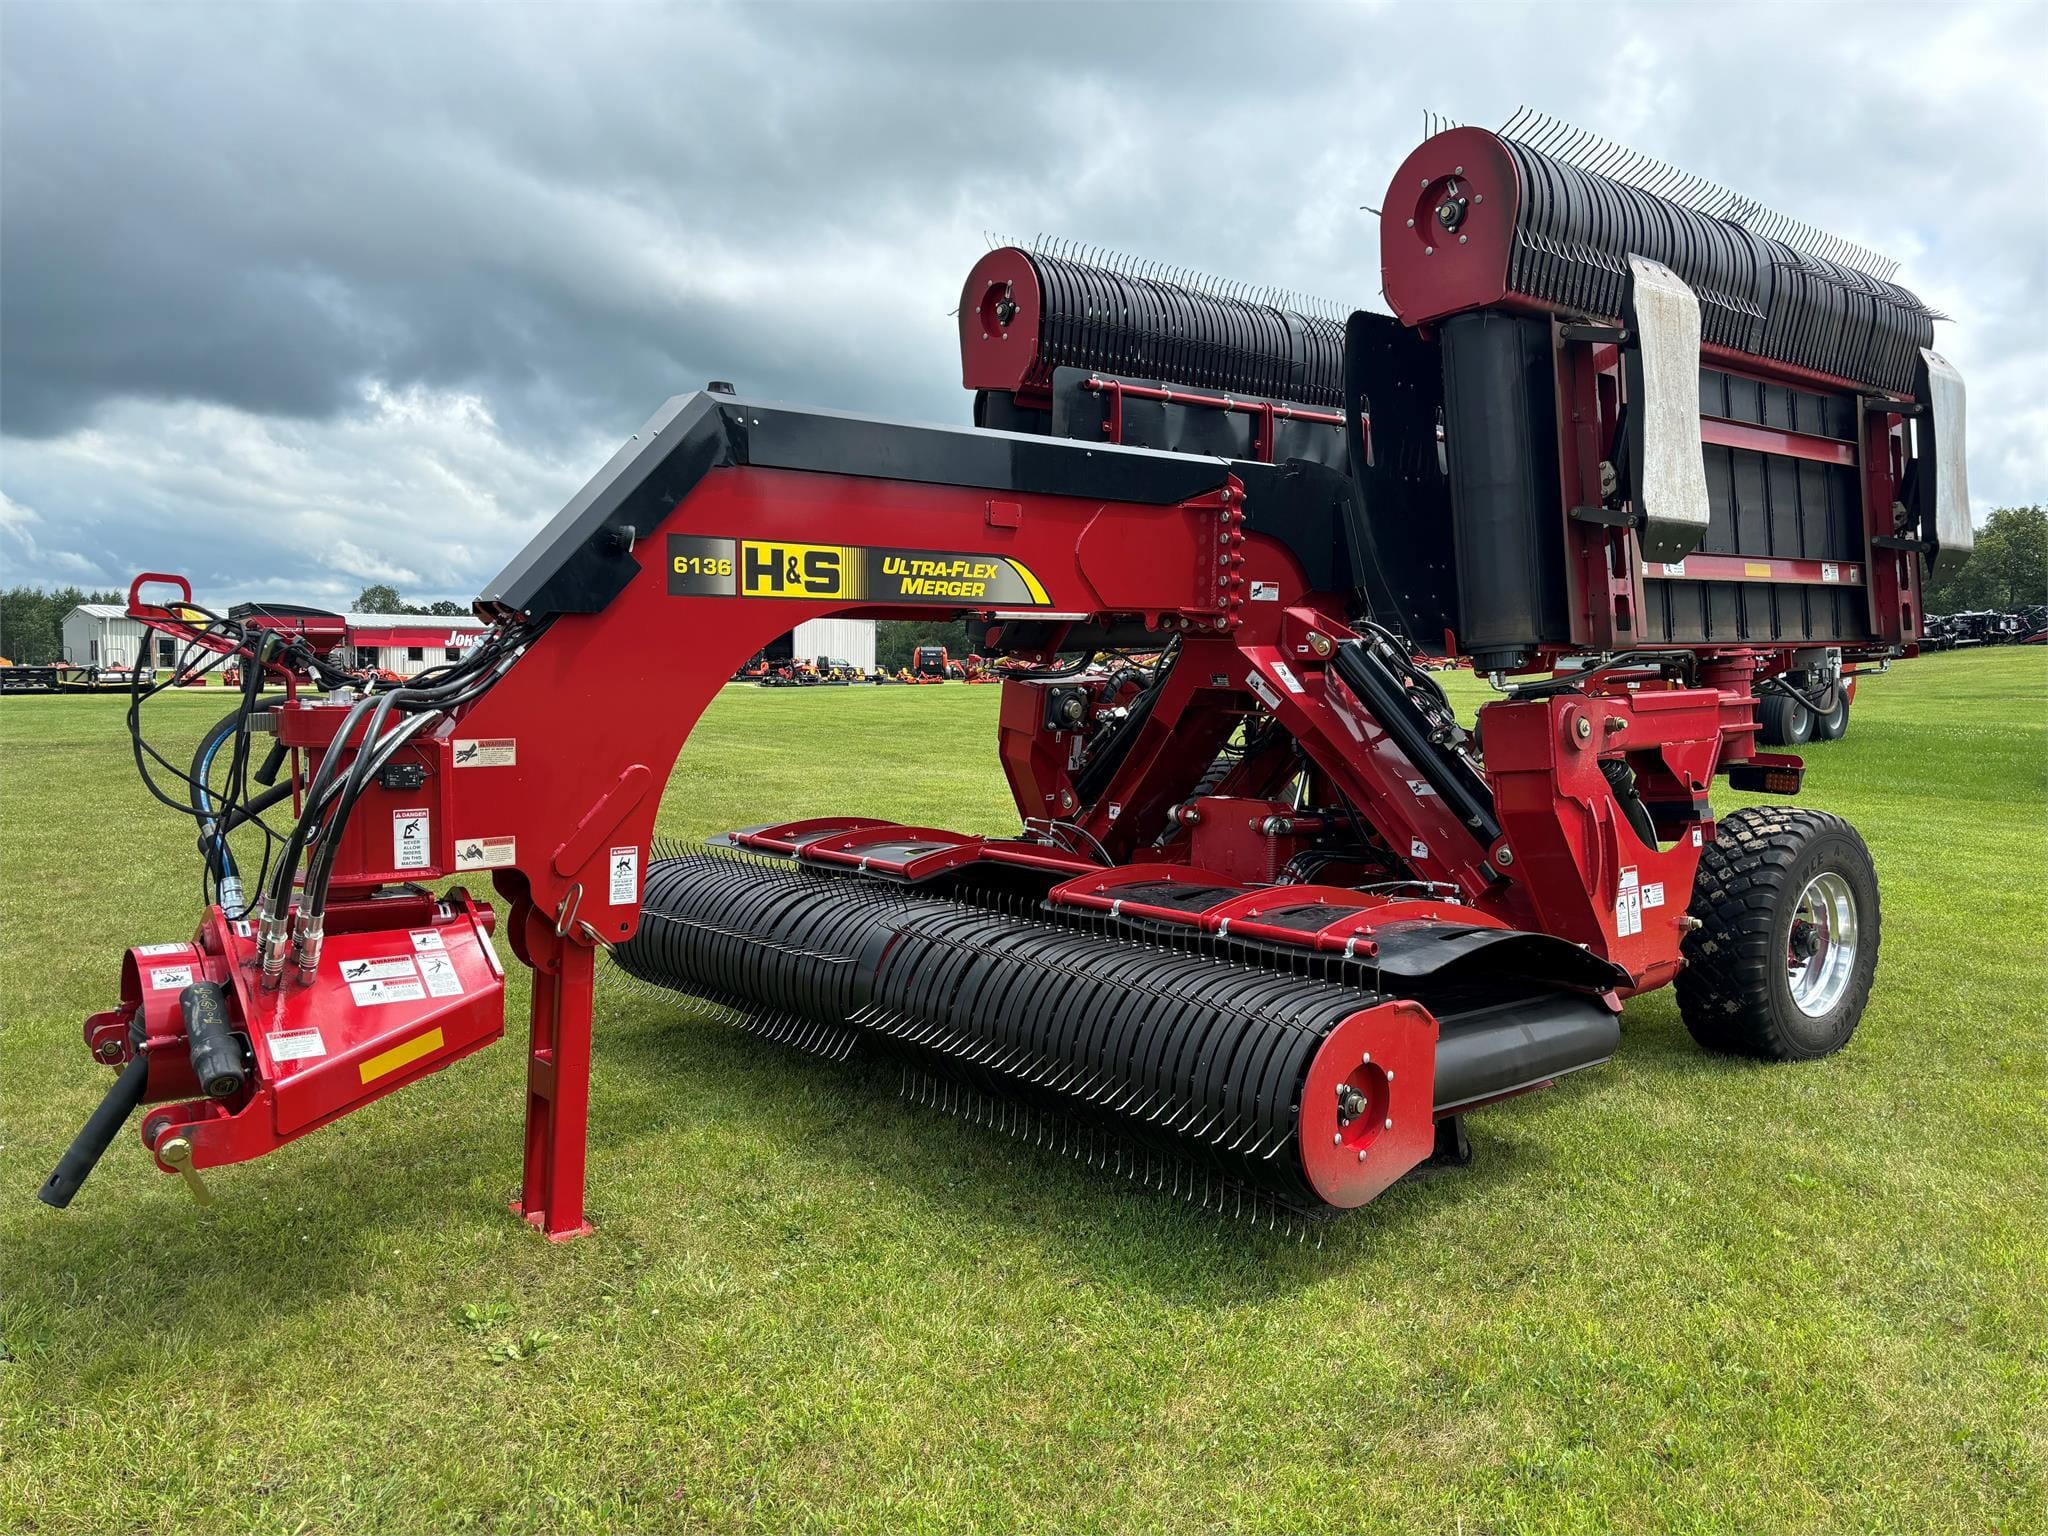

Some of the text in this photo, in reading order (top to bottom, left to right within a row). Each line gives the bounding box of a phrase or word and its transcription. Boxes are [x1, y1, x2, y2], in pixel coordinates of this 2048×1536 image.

[673, 556, 732, 576] 6136
[745, 547, 840, 594] H&S
[883, 557, 998, 579] ULTRA-FLEX
[900, 577, 986, 597] MERGER
